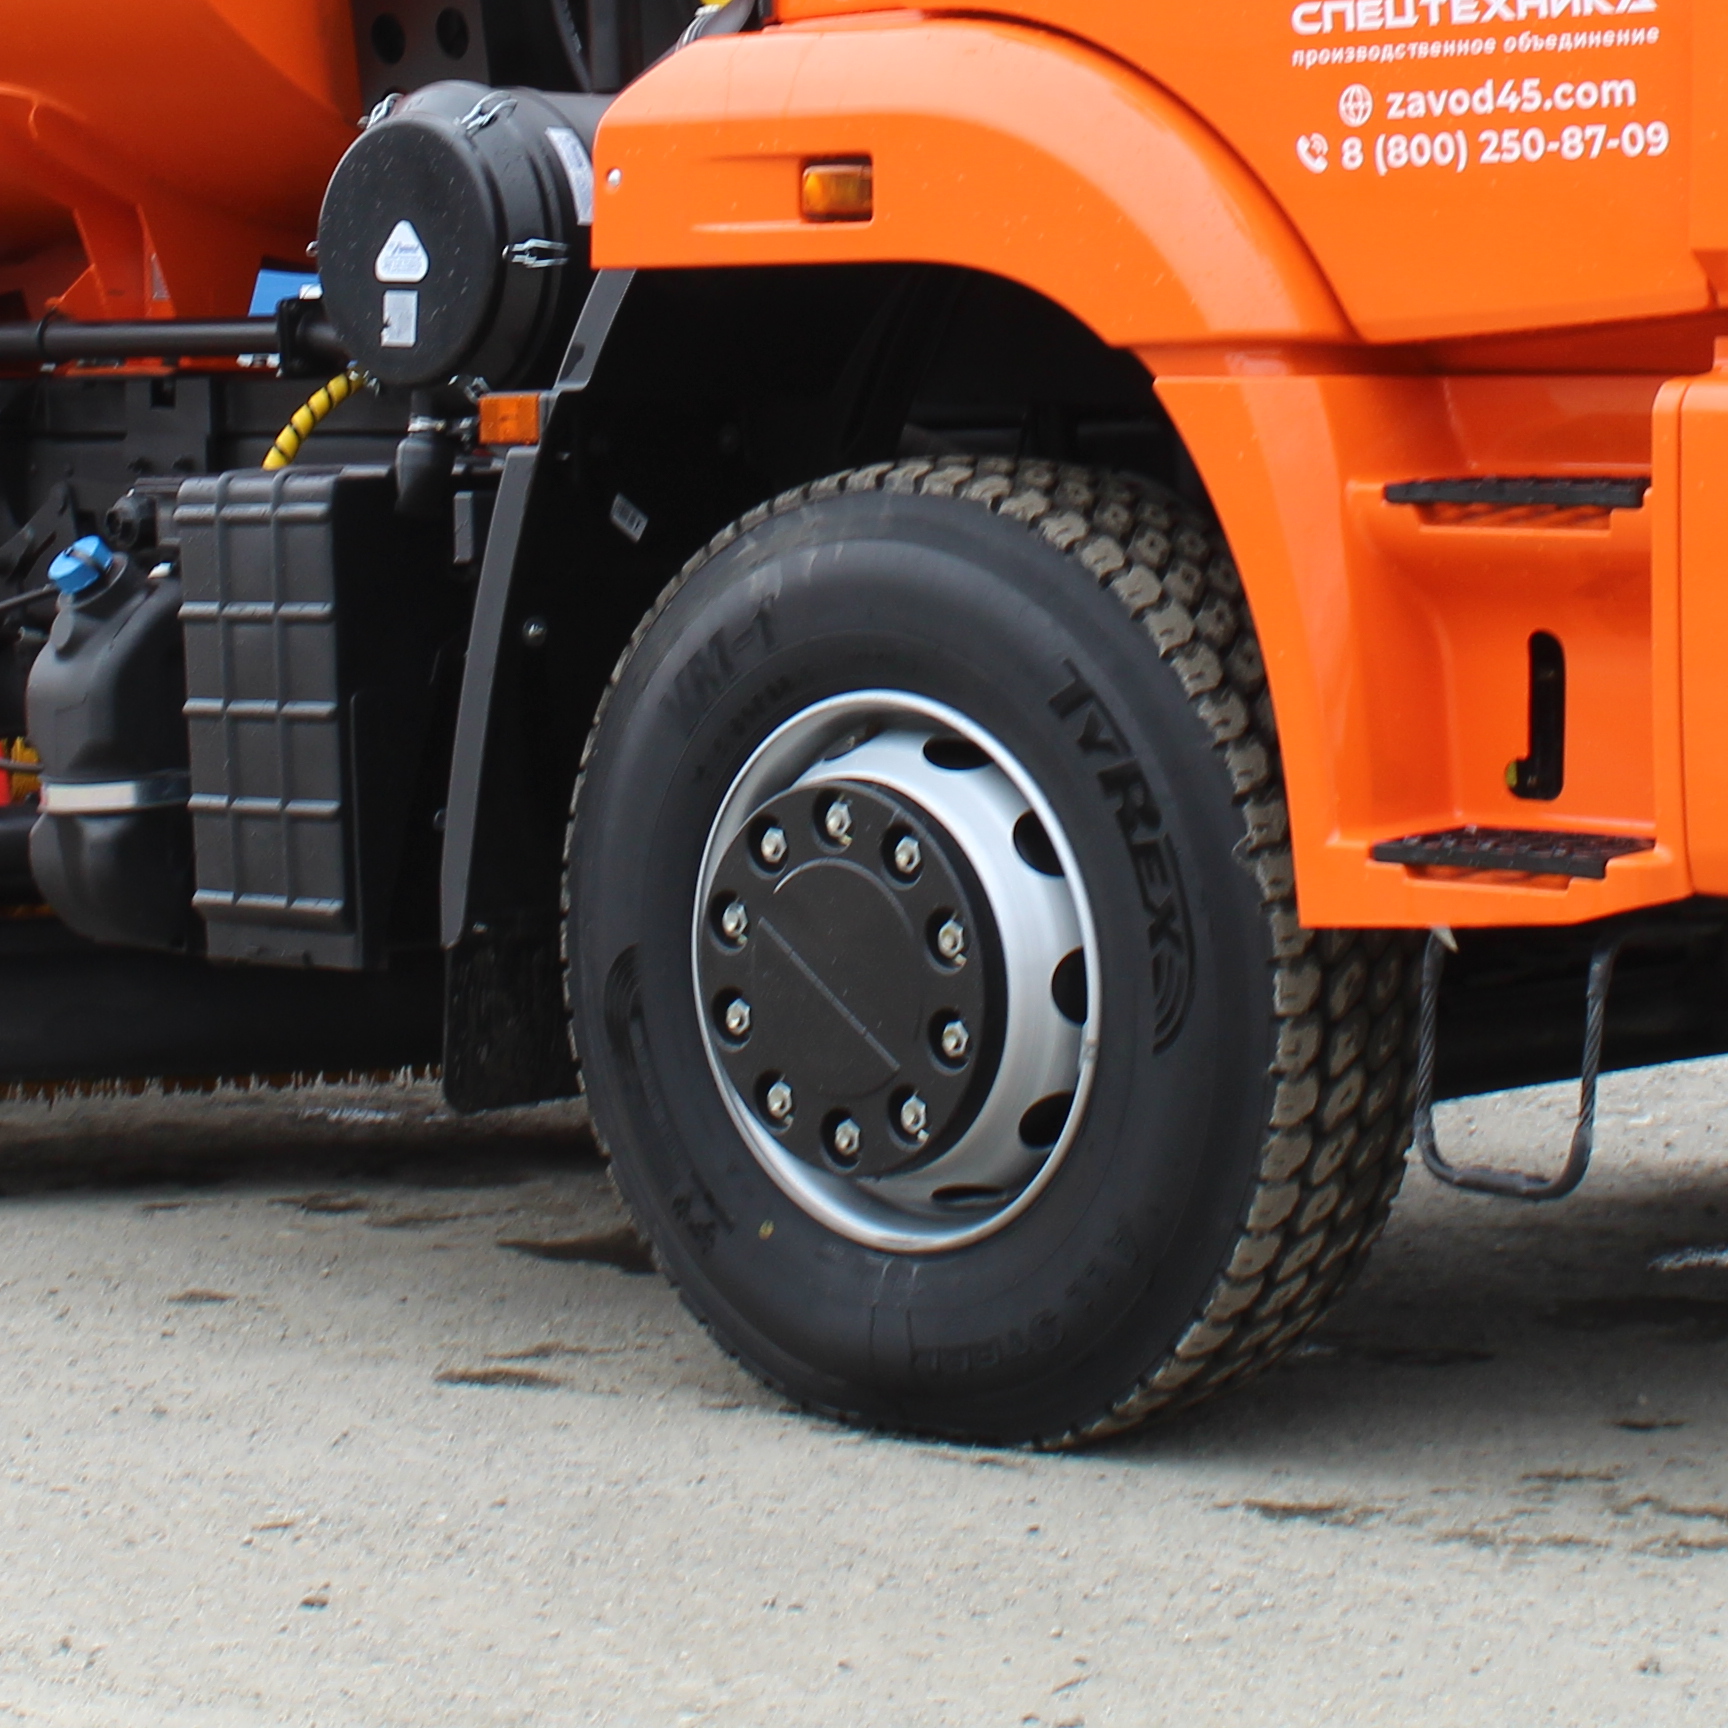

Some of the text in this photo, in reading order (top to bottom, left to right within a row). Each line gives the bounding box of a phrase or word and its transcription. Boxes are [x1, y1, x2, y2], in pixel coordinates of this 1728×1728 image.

[1291, 26, 1660, 70] производственное объединение
[1386, 78, 1637, 120] zavod45.com
[1340, 121, 1670, 176] 8 (800) 250-87-09
